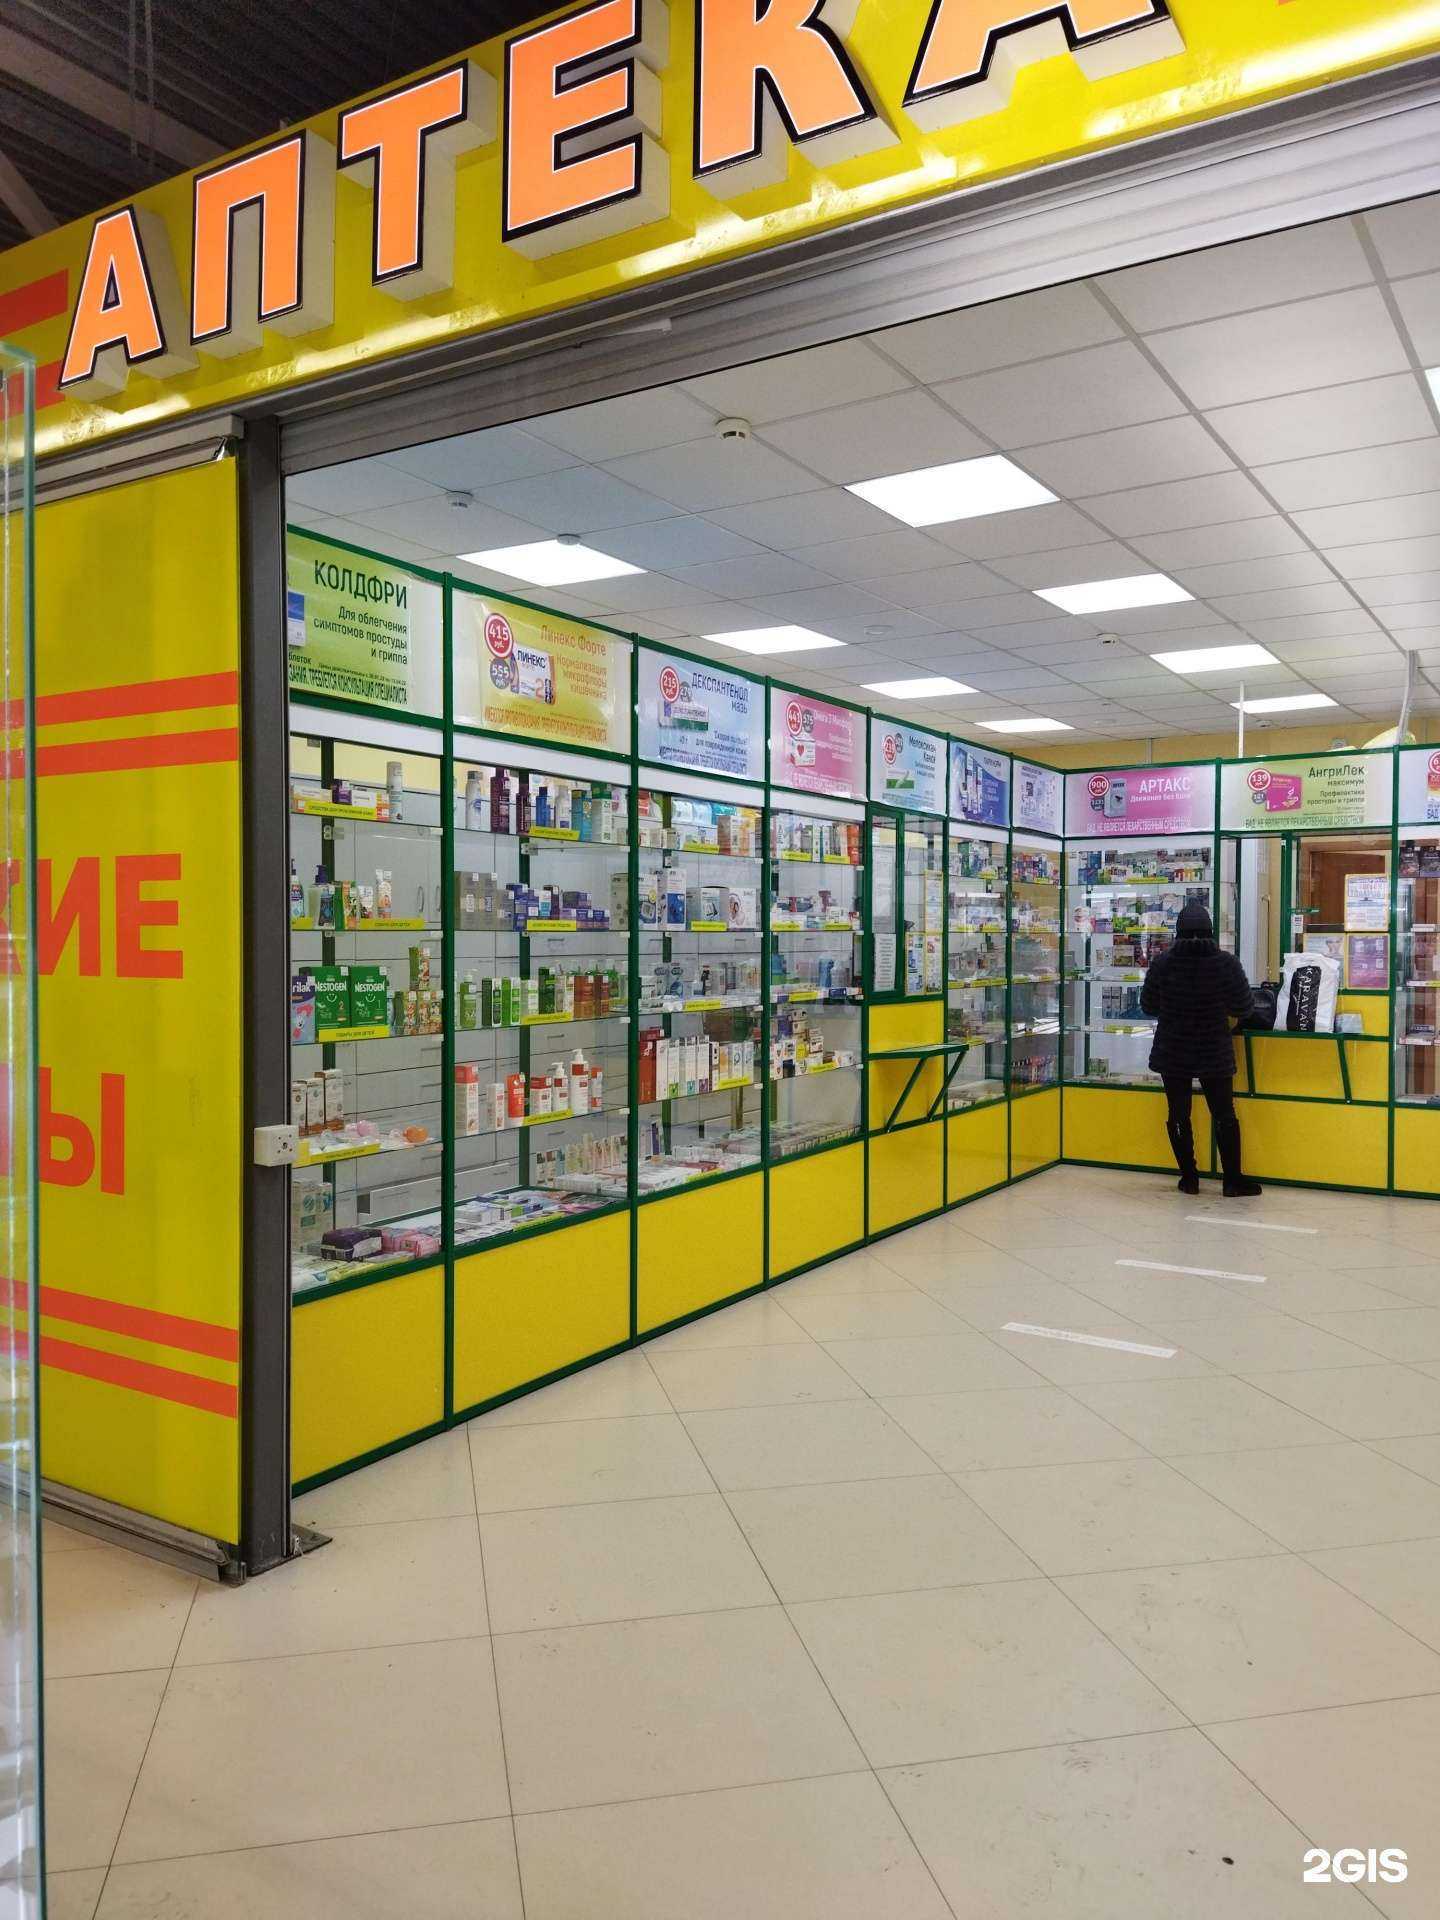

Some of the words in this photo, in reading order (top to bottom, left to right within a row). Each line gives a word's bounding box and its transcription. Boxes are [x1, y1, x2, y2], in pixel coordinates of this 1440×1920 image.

[314, 559, 408, 610] КОЛДФРИ
[338, 605, 357, 622] Для
[358, 612, 408, 634] облегчения
[313, 618, 365, 639] симптомов
[366, 630, 408, 650] простуды
[489, 622, 509, 641] 415
[541, 624, 577, 649] Линекс
[577, 634, 607, 657] Форте
[371, 647, 377, 658] и
[378, 649, 408, 665] гриппа
[663, 674, 677, 689] 215
[691, 672, 748, 702] ДЕКСПАНТЕНОЛ
[1251, 773, 1269, 783] 139
[1308, 764, 1366, 779] АнгриЛек
[1091, 781, 1107, 789] 900
[1138, 777, 1192, 794] АРТАКС
[1327, 779, 1366, 788] максимум
[314, 980, 347, 992] NESTOGEN
[354, 980, 385, 993] NESTOGEN
[1300, 966, 1313, 1032] KARAVAN
